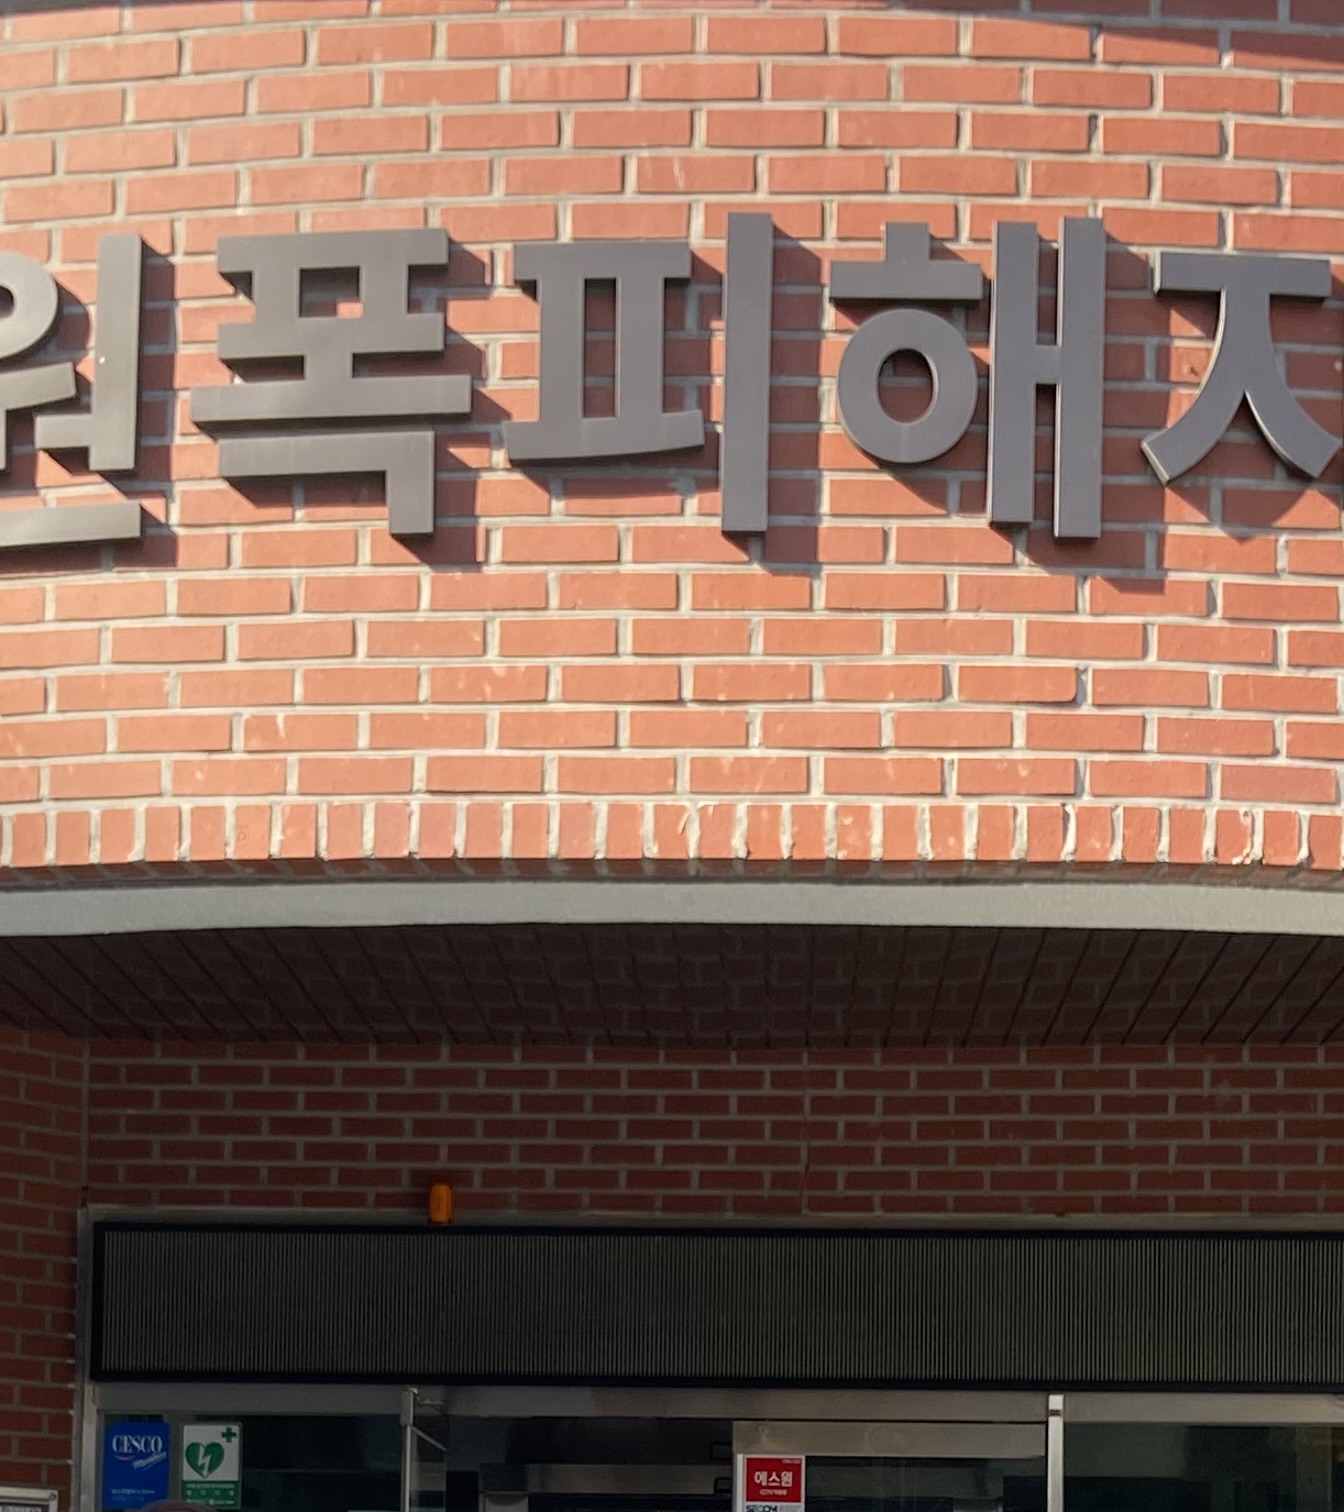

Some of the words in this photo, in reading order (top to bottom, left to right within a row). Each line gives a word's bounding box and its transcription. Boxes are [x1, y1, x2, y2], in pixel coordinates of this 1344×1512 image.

[112, 1435, 163, 1454] CESCO
[754, 1471, 793, 1487] 에스원
[746, 1505, 778, 1512] SECOM
